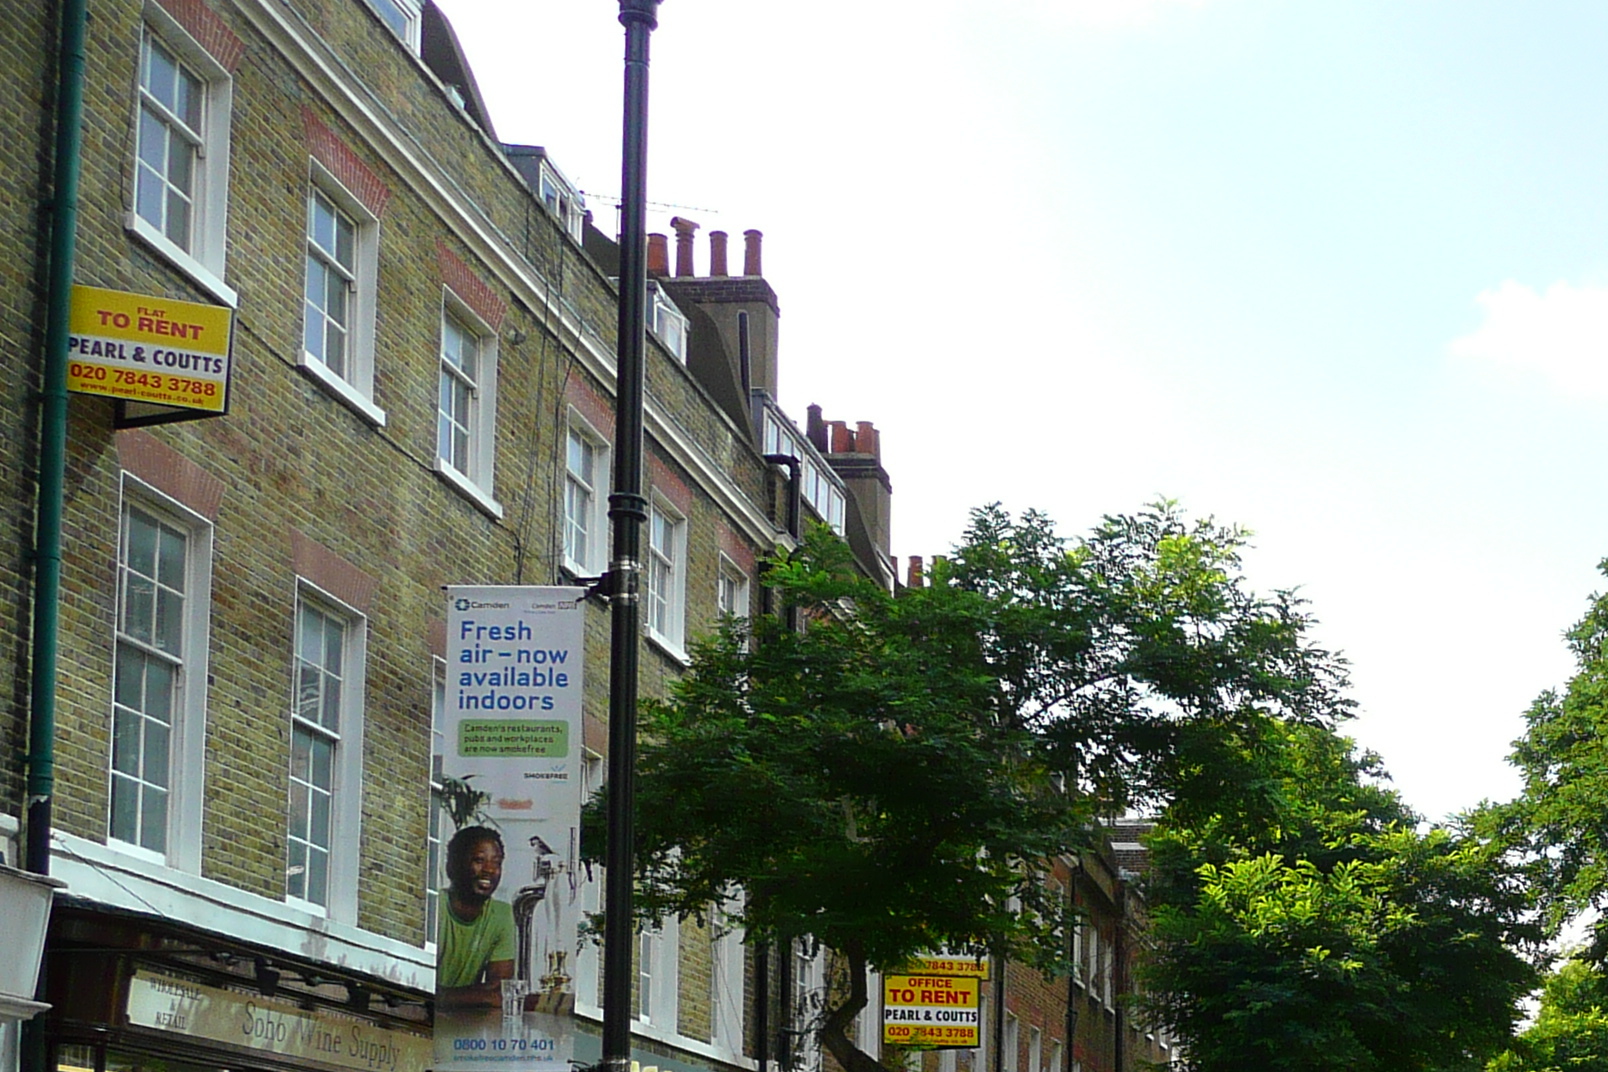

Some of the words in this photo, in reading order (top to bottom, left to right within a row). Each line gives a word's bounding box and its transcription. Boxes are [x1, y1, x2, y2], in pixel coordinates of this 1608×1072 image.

[137, 306, 166, 318] FLAT
[97, 309, 131, 330] TO
[137, 316, 204, 341] RENT
[69, 336, 127, 361] PEARL
[132, 345, 146, 364] &
[153, 349, 223, 375] COUTTS
[70, 363, 107, 381] 020
[113, 369, 162, 390] 7843
[168, 377, 215, 397] 3788
[461, 620, 531, 640] Fresh
[460, 643, 493, 663] air
[517, 649, 568, 664] now
[459, 666, 569, 687] available
[459, 689, 554, 710] indoors
[507, 724, 562, 734] restaurants,
[464, 735, 485, 743] pubs
[487, 734, 502, 742] and
[503, 734, 554, 743] workplaces
[499, 744, 546, 753] smokefree
[908, 978, 952, 988] OFFICE
[889, 989, 915, 1003] TO
[921, 990, 971, 1004] RENT
[155, 1011, 186, 1030] RETAIL
[885, 1009, 920, 1021] PEARL
[924, 1011, 932, 1021] &
[936, 1011, 977, 1022] COUTTS
[242, 1000, 286, 1042] Soho
[299, 1013, 342, 1054] Wine
[349, 1025, 400, 1072] Supply
[888, 1027, 910, 1036] 020
[946, 1029, 974, 1038] 3788
[454, 1039, 486, 1050] 0800
[491, 1040, 506, 1050] 10
[510, 1040, 527, 1050] 70
[530, 1039, 554, 1050] 401
